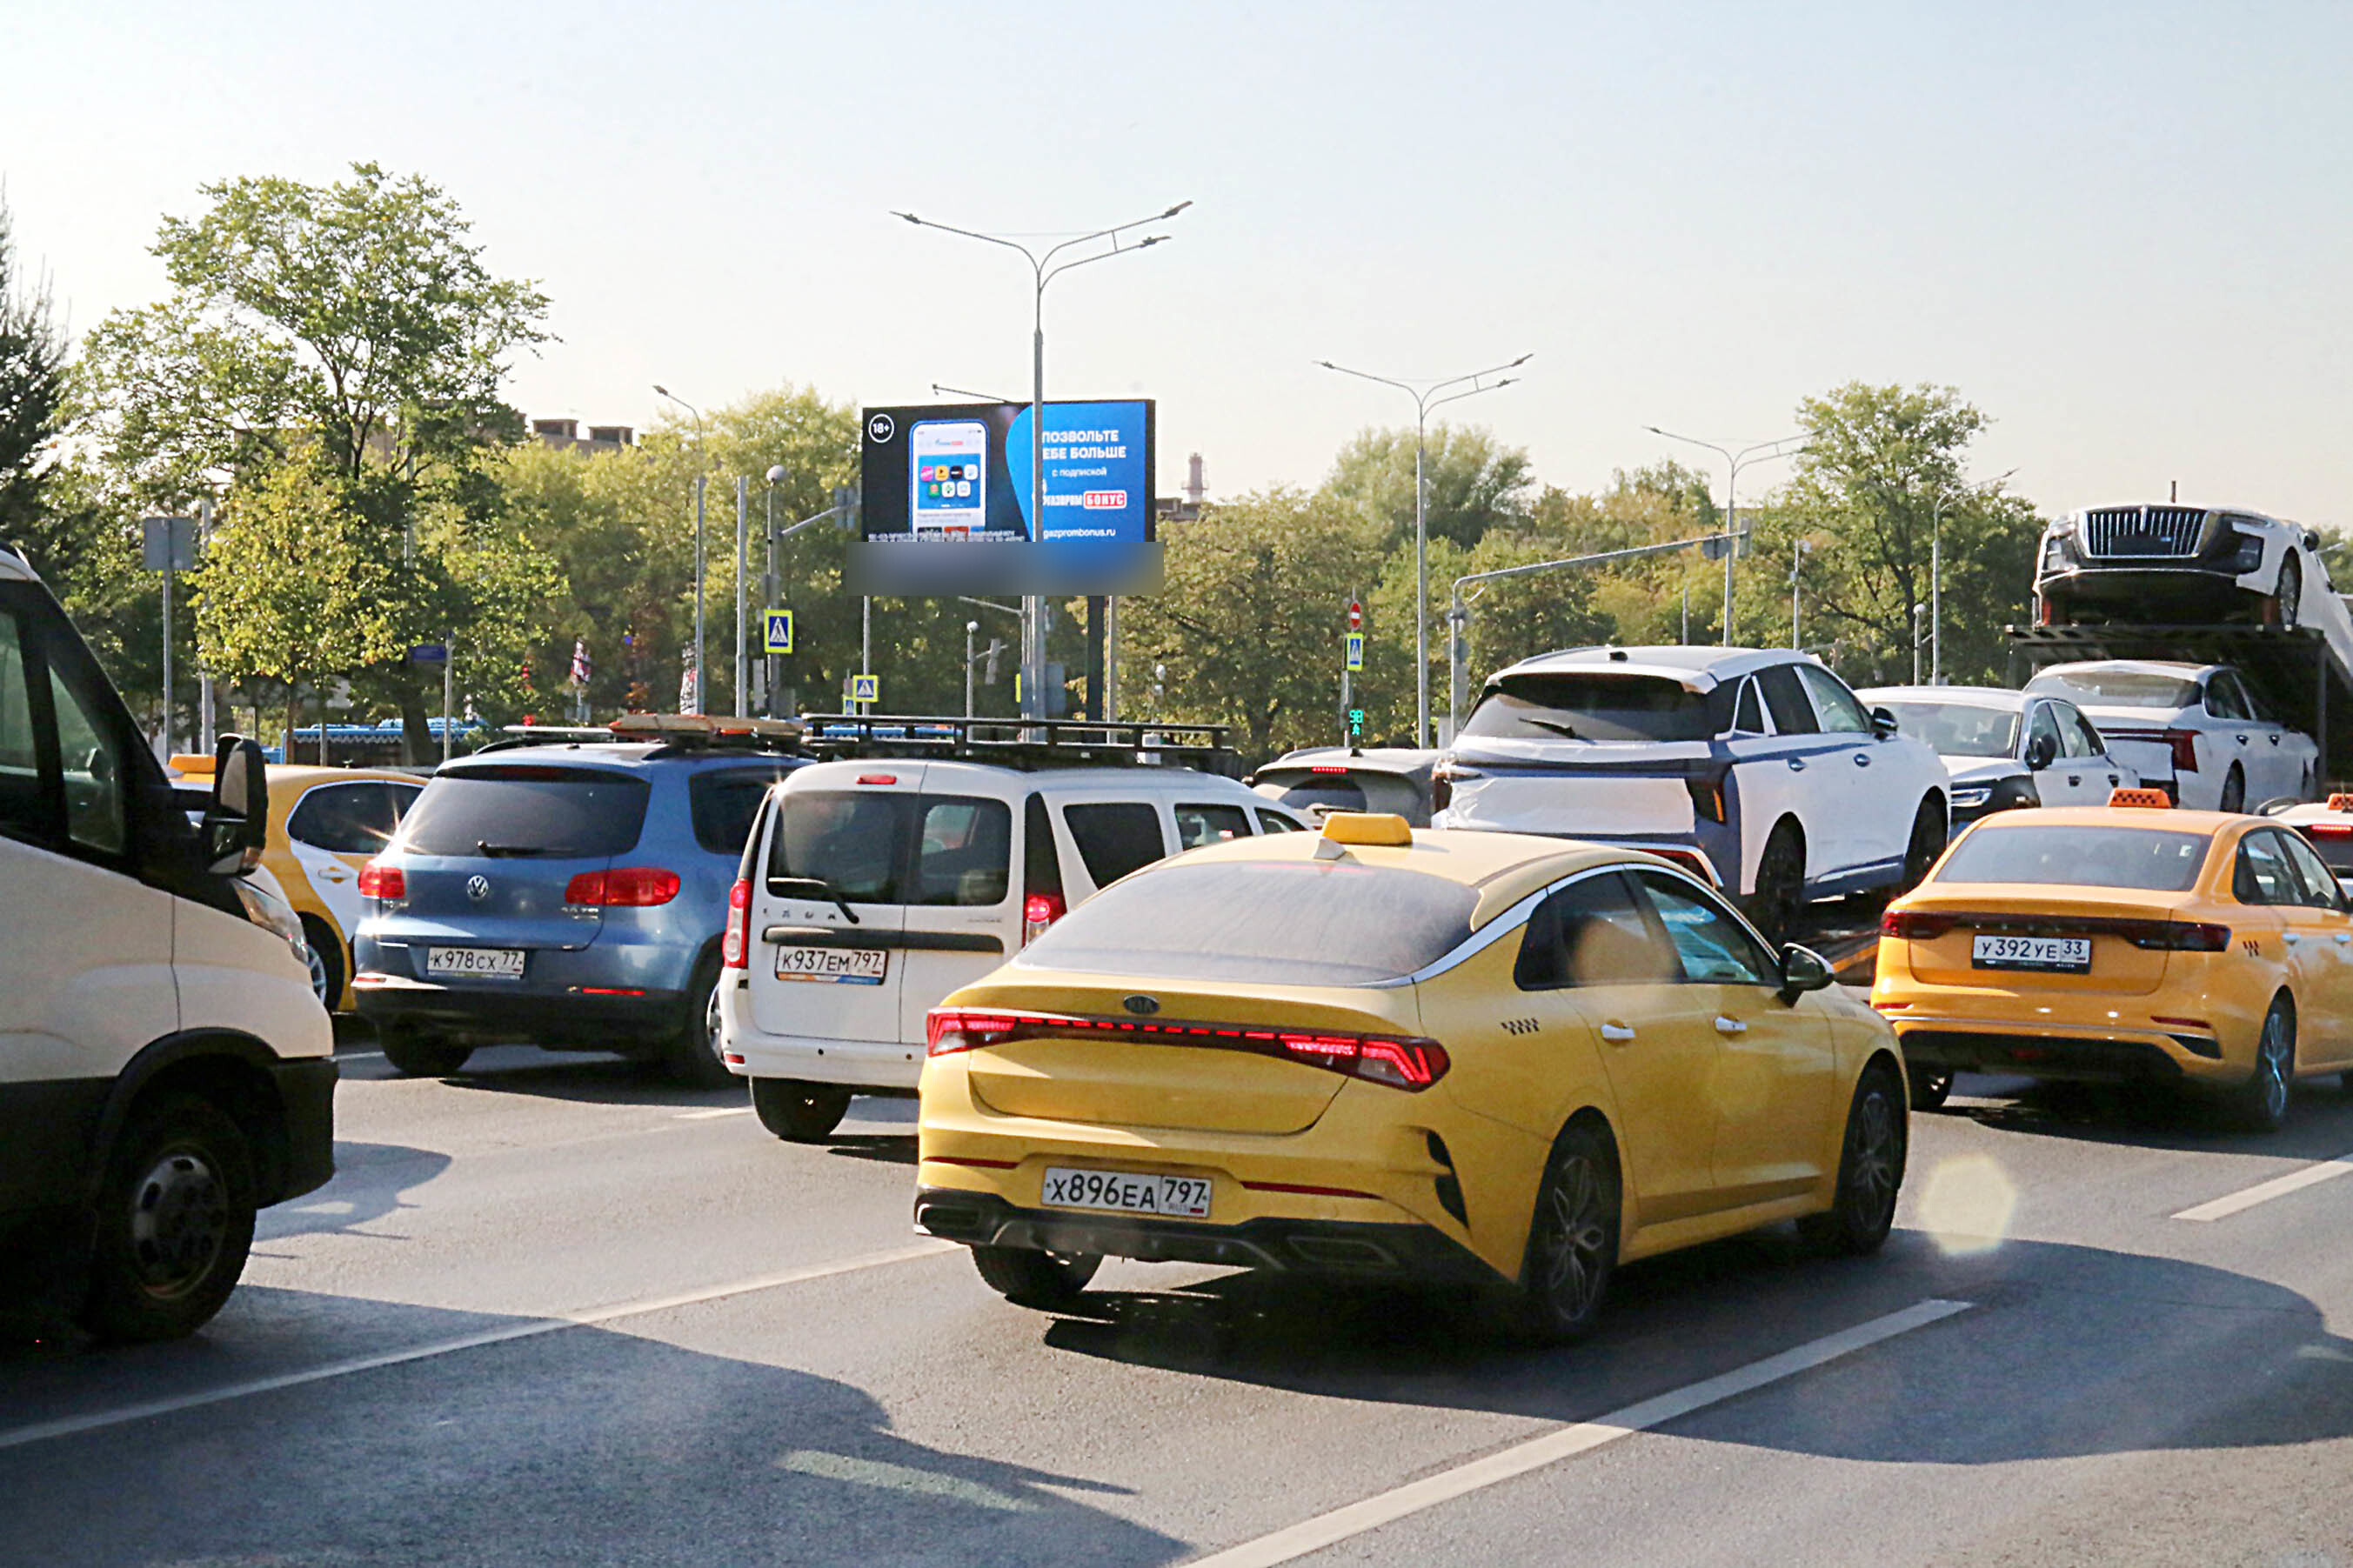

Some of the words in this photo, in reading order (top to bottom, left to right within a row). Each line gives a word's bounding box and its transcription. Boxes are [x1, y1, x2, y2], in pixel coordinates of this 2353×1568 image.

[872, 423, 890, 434] 18+
[1042, 430, 1120, 443] ПОЗВОЛЬТЕ
[1042, 447, 1067, 460] ЕБЕ
[1070, 446, 1126, 459] БОЛЬШЕ
[1060, 467, 1107, 477] подпиской
[1086, 494, 1124, 505] БОНУС
[1043, 528, 1116, 539] gazprombonus.ru
[2062, 940, 2083, 955] 33
[502, 951, 519, 966] 77
[853, 951, 881, 968] 797
[1164, 1178, 1207, 1205] 797
